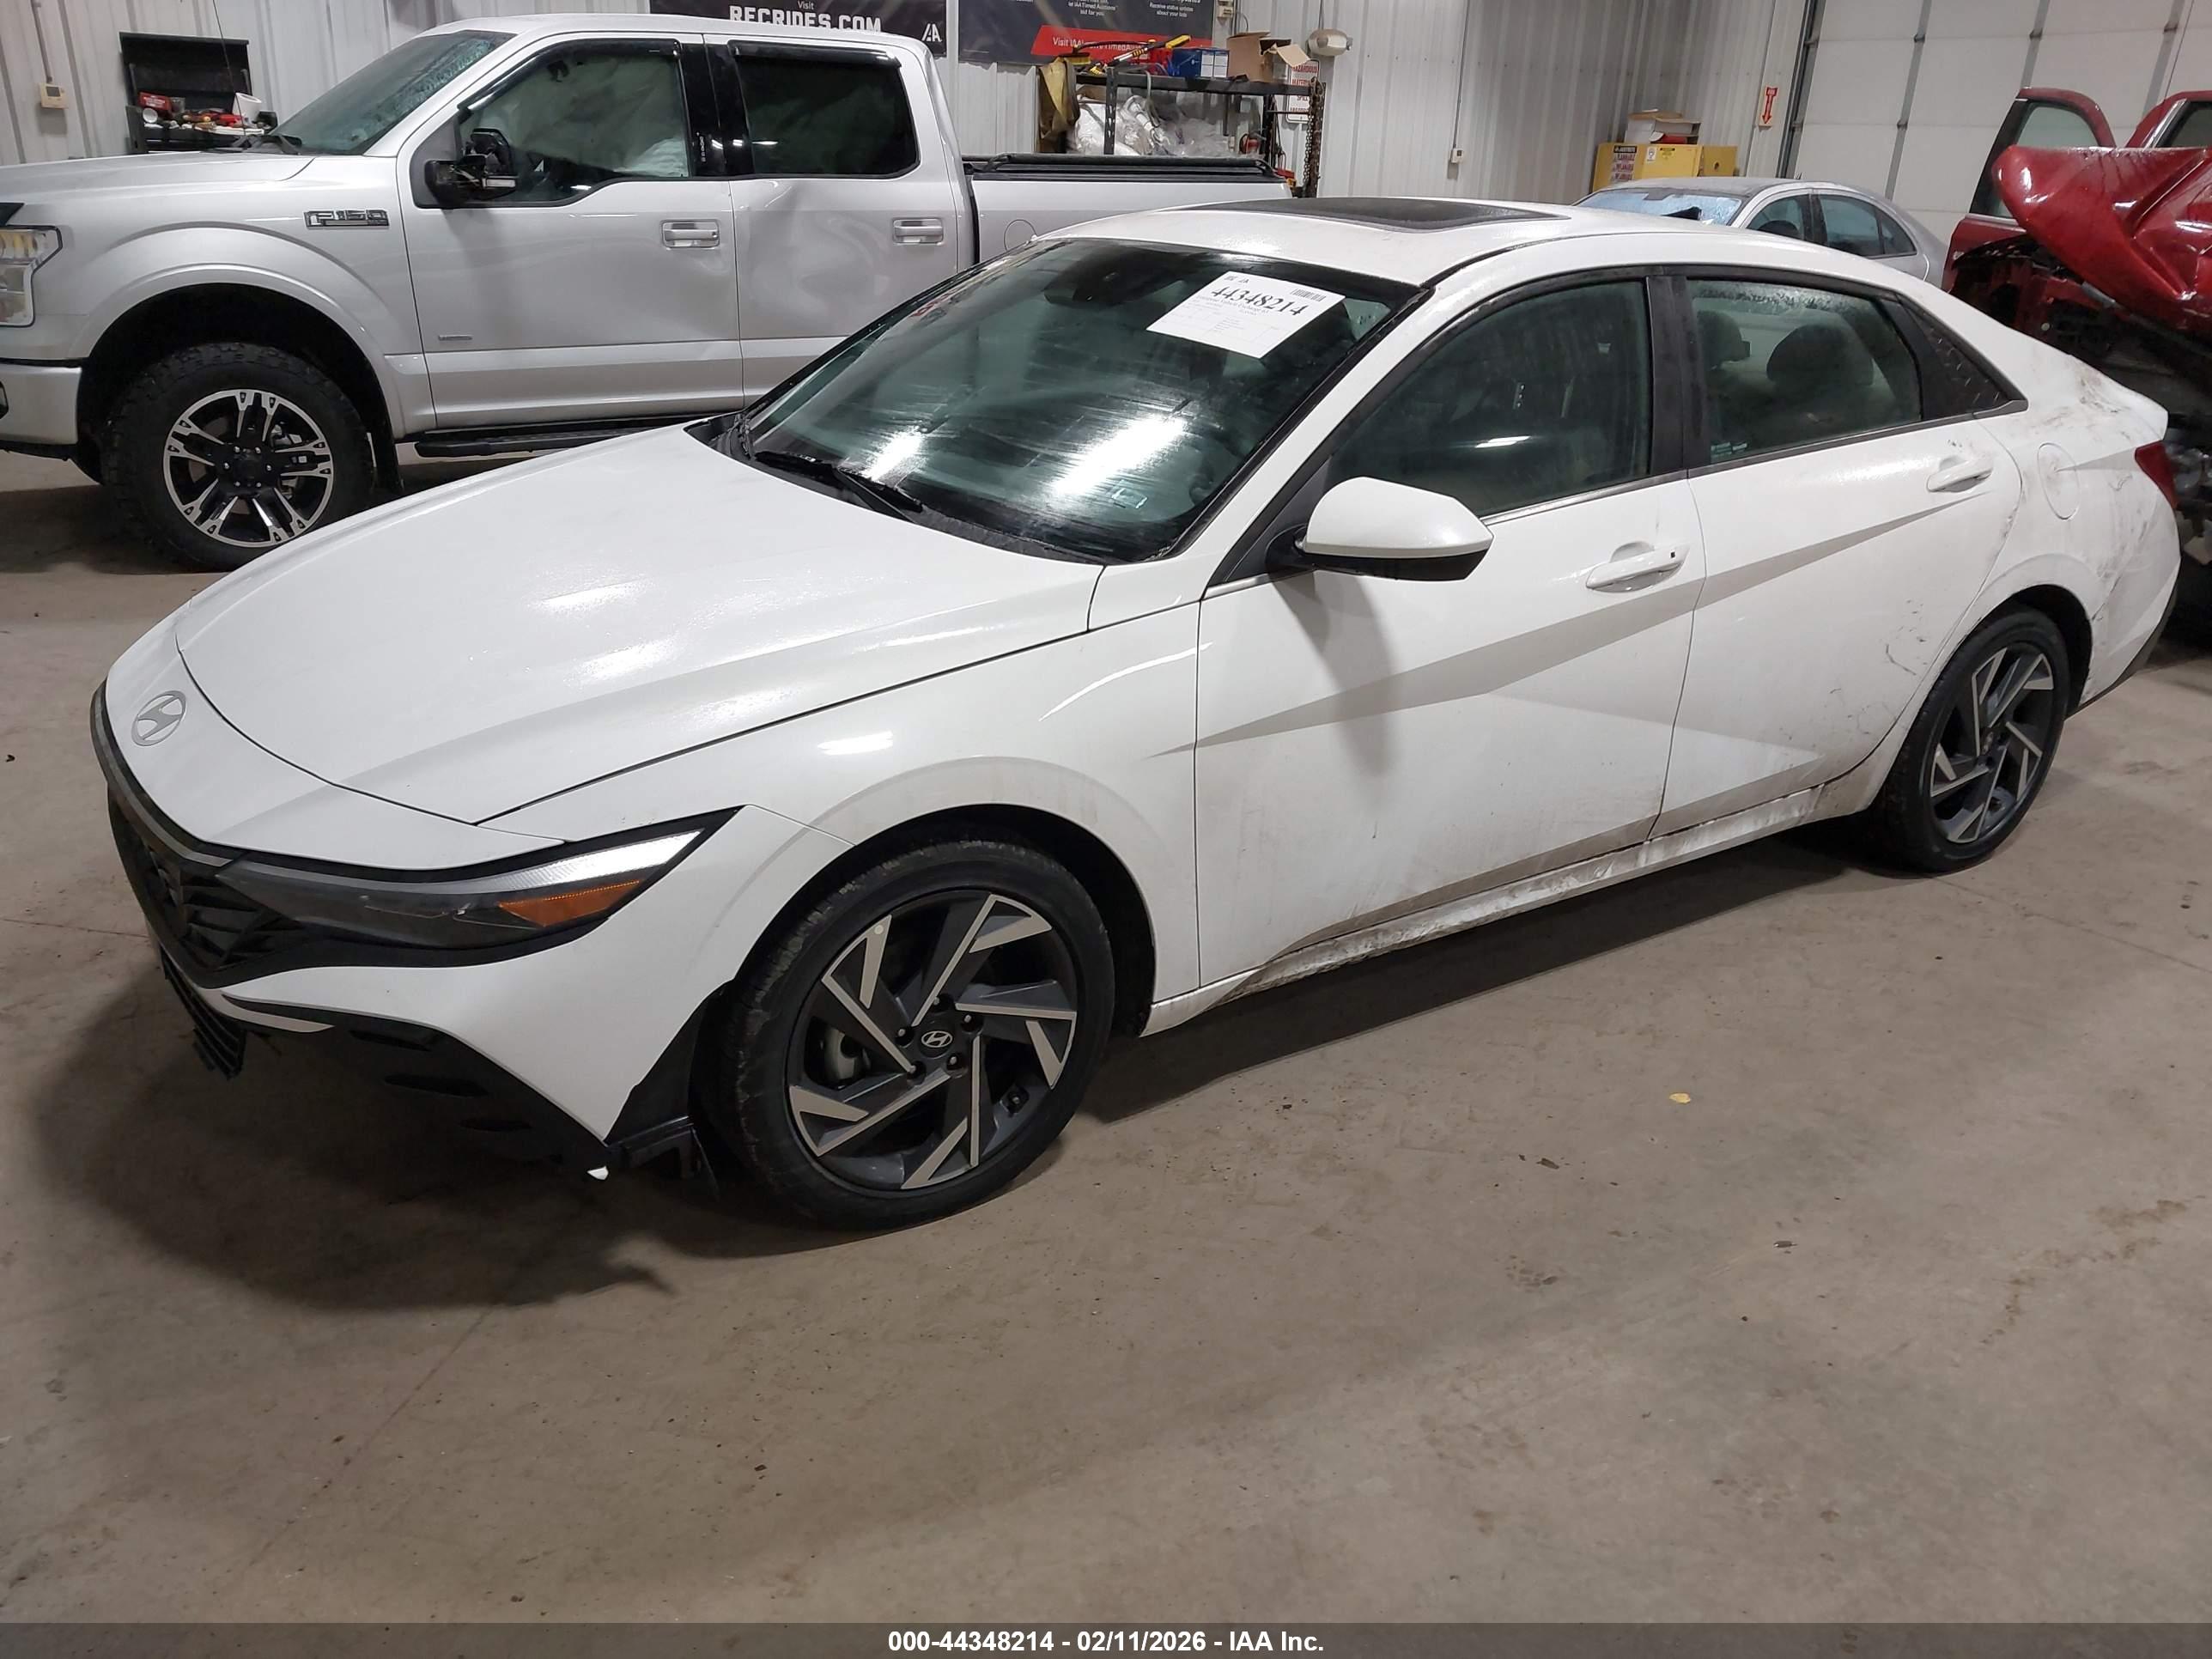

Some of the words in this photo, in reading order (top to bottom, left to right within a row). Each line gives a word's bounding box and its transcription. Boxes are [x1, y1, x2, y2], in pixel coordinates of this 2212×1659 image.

[798, 1, 815, 9] Visit
[1053, 37, 1068, 46] Visit
[1211, 286, 1310, 316] 44348214
